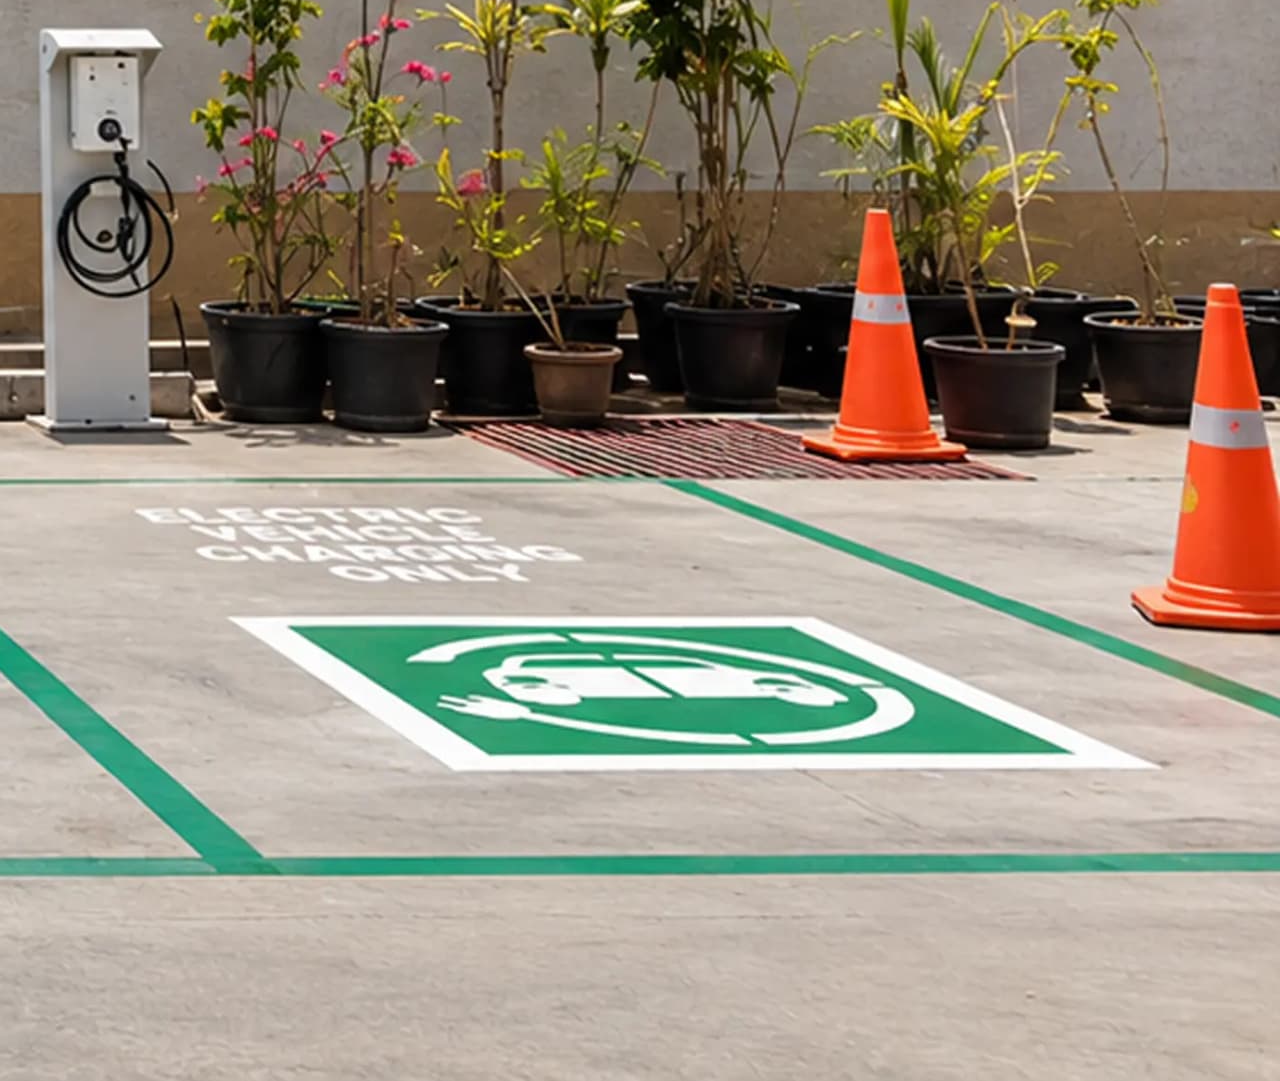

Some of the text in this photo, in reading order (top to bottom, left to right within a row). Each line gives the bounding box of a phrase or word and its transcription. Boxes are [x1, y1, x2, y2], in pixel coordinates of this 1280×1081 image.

[134, 507, 482, 524] ELECTRIC
[190, 524, 496, 542] VEHICLE
[195, 544, 583, 562] CHARGING
[329, 564, 529, 582] ONLY
